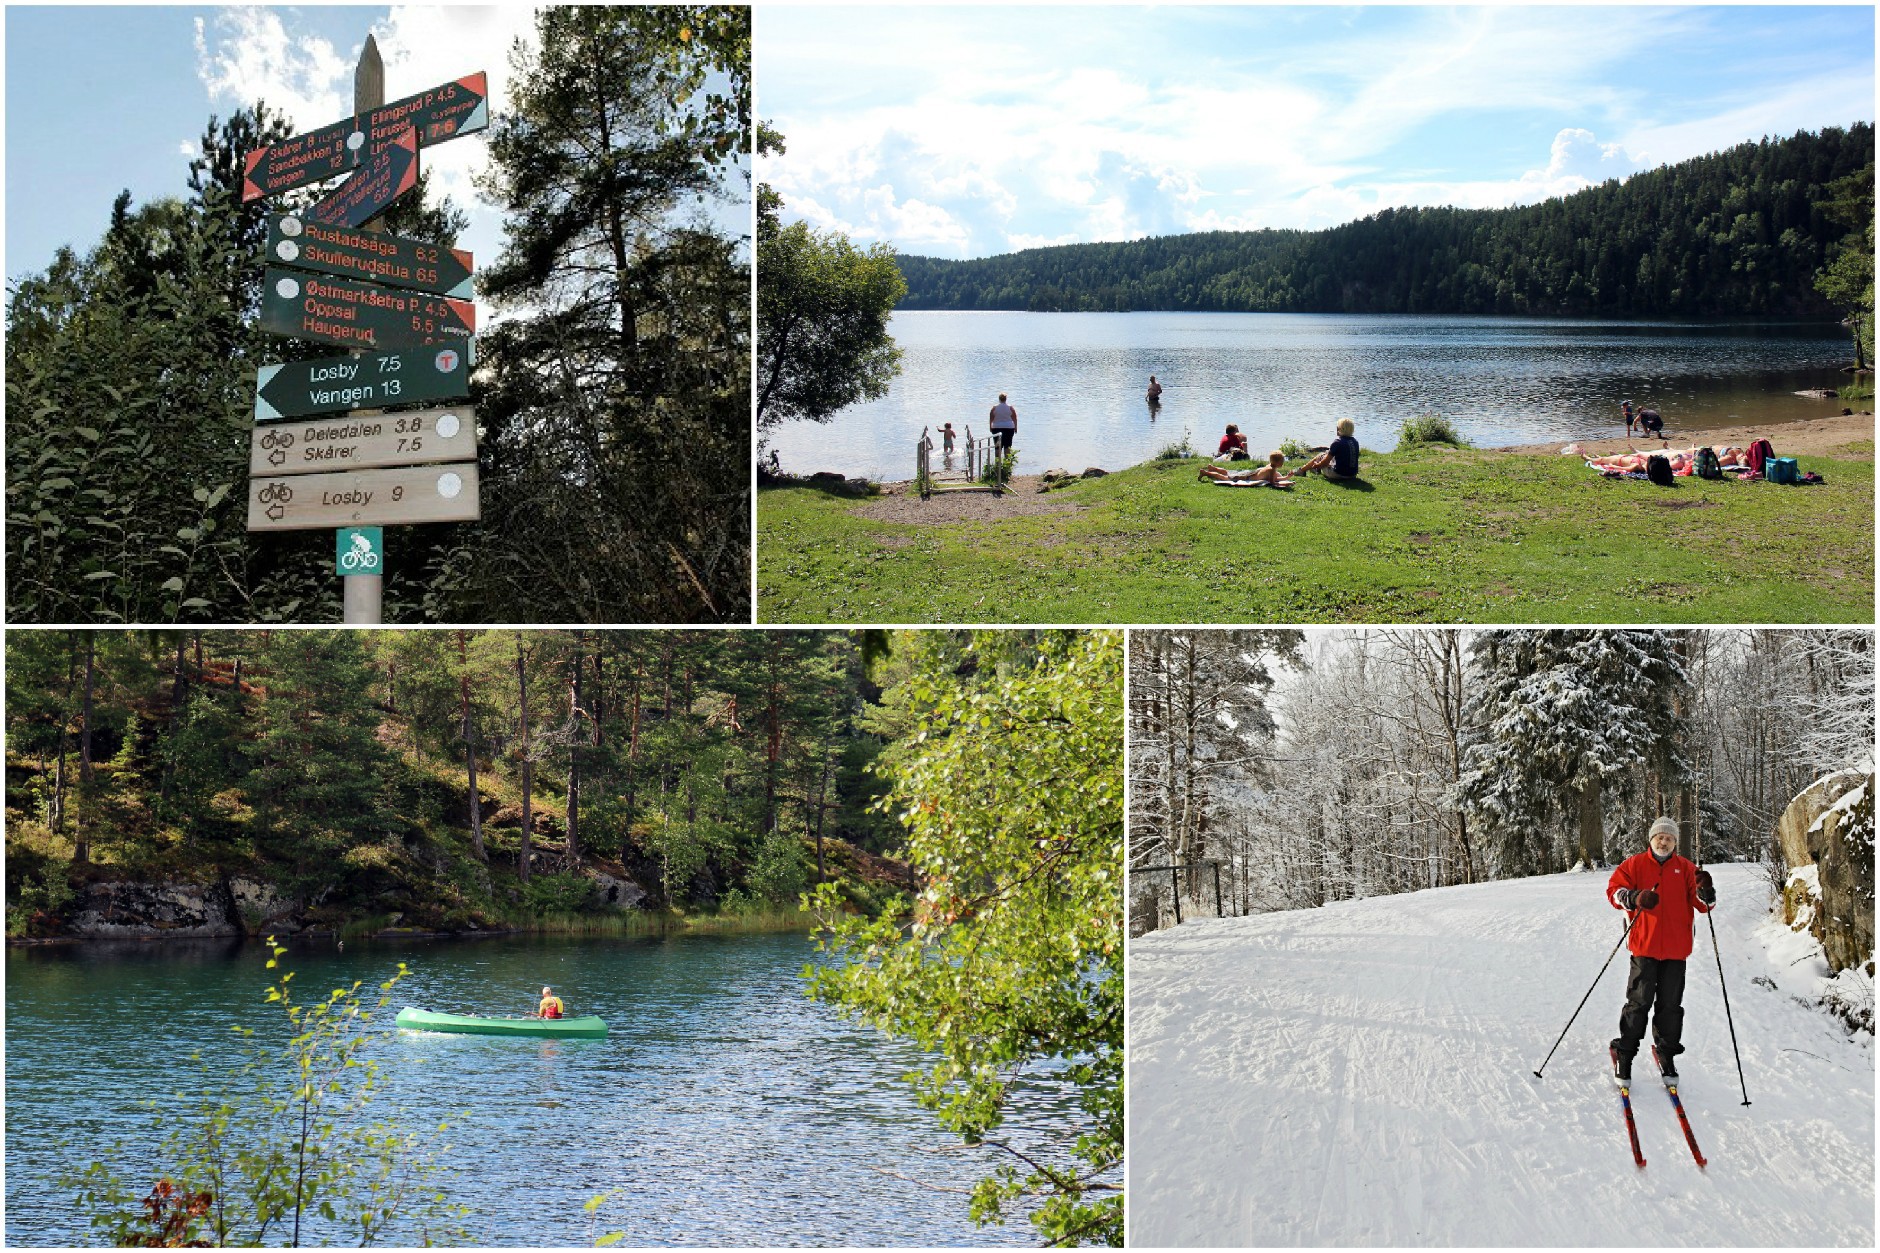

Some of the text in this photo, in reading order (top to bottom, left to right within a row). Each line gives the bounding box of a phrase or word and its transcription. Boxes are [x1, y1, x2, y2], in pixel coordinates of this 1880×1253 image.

[437, 86, 456, 101] 4.5
[307, 134, 315, 148] 8
[268, 139, 343, 175] Sandbakken 8
[266, 169, 305, 189] Vangen
[305, 224, 438, 263] Rustadsaga 6.2
[304, 245, 438, 283] Skullerudstua 6.5
[305, 279, 405, 310] Østmarksetra
[425, 301, 448, 317] 4.5
[304, 298, 433, 334] Oppsal 5.5
[303, 317, 374, 341] Haugerud
[310, 355, 402, 383] Losby 7.5
[310, 380, 402, 405] Vangen 13
[304, 417, 423, 443] Deledalen 3.8
[304, 437, 423, 461] Skårer 7.5
[322, 485, 403, 507] Losby 9
